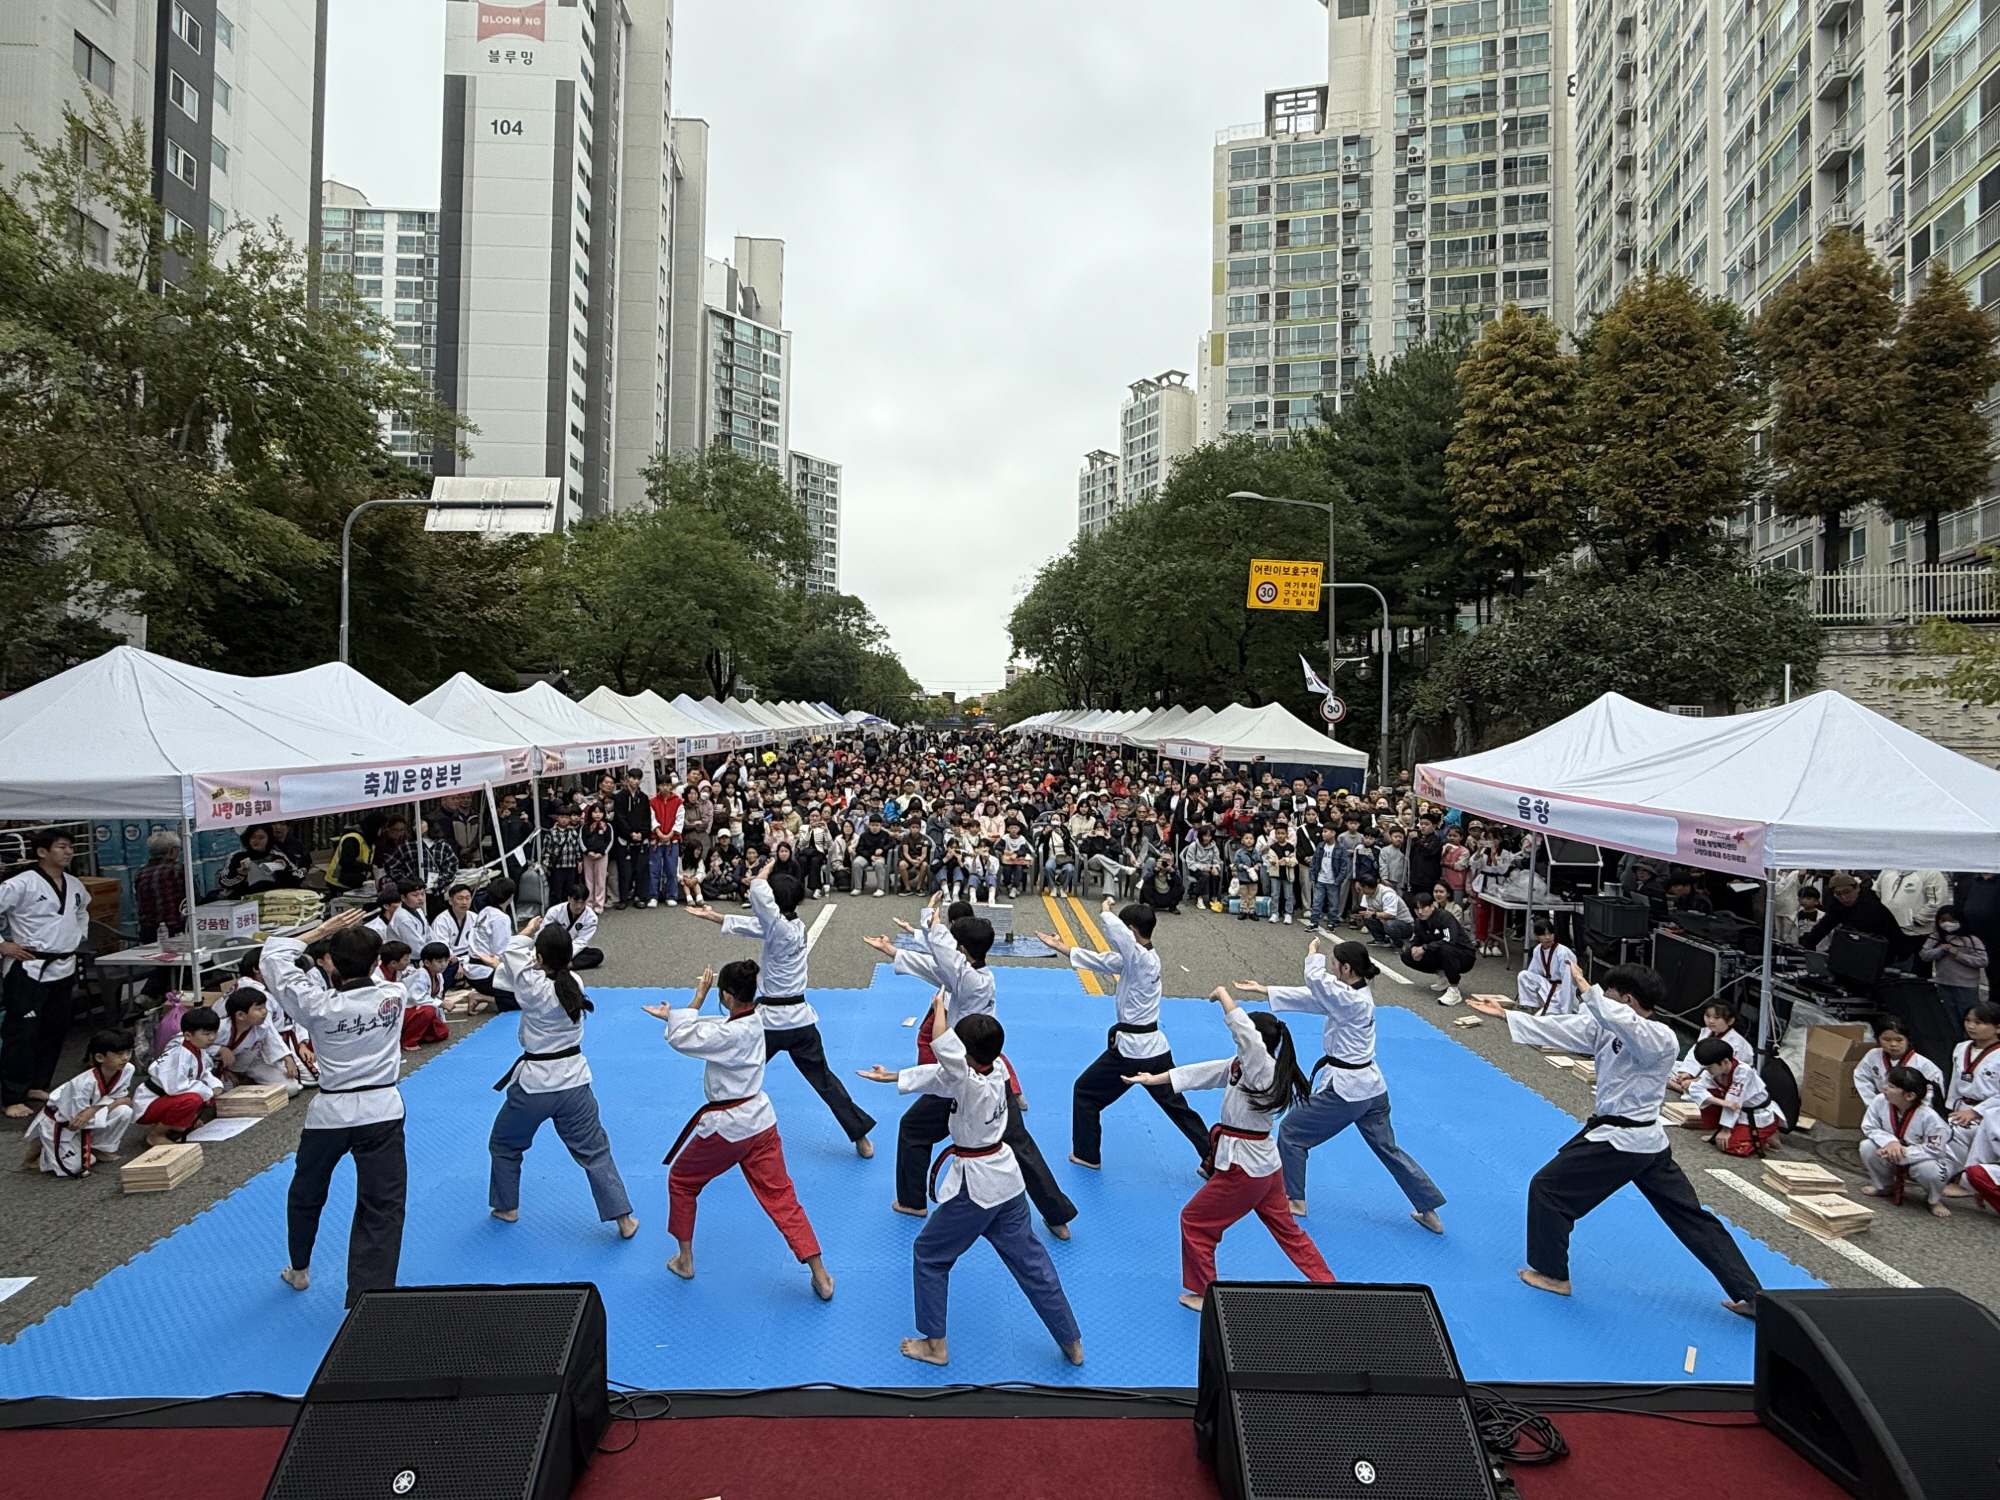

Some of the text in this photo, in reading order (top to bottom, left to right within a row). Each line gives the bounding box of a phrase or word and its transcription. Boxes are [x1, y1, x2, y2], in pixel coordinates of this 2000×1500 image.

[488, 49, 534, 66] 블루밍
[490, 119, 524, 136] 104
[1254, 564, 1319, 578] 어린이보호구역
[1260, 587, 1274, 598] 30
[1327, 703, 1340, 714] 30
[587, 746, 616, 764] 자원봉사
[264, 780, 270, 792] 1
[364, 763, 462, 797] 축제운영본부
[211, 800, 272, 820] 사랑 마을 축제
[1517, 796, 1550, 825] 음향
[196, 918, 230, 931] 경품함
[235, 912, 257, 929] 경품함
